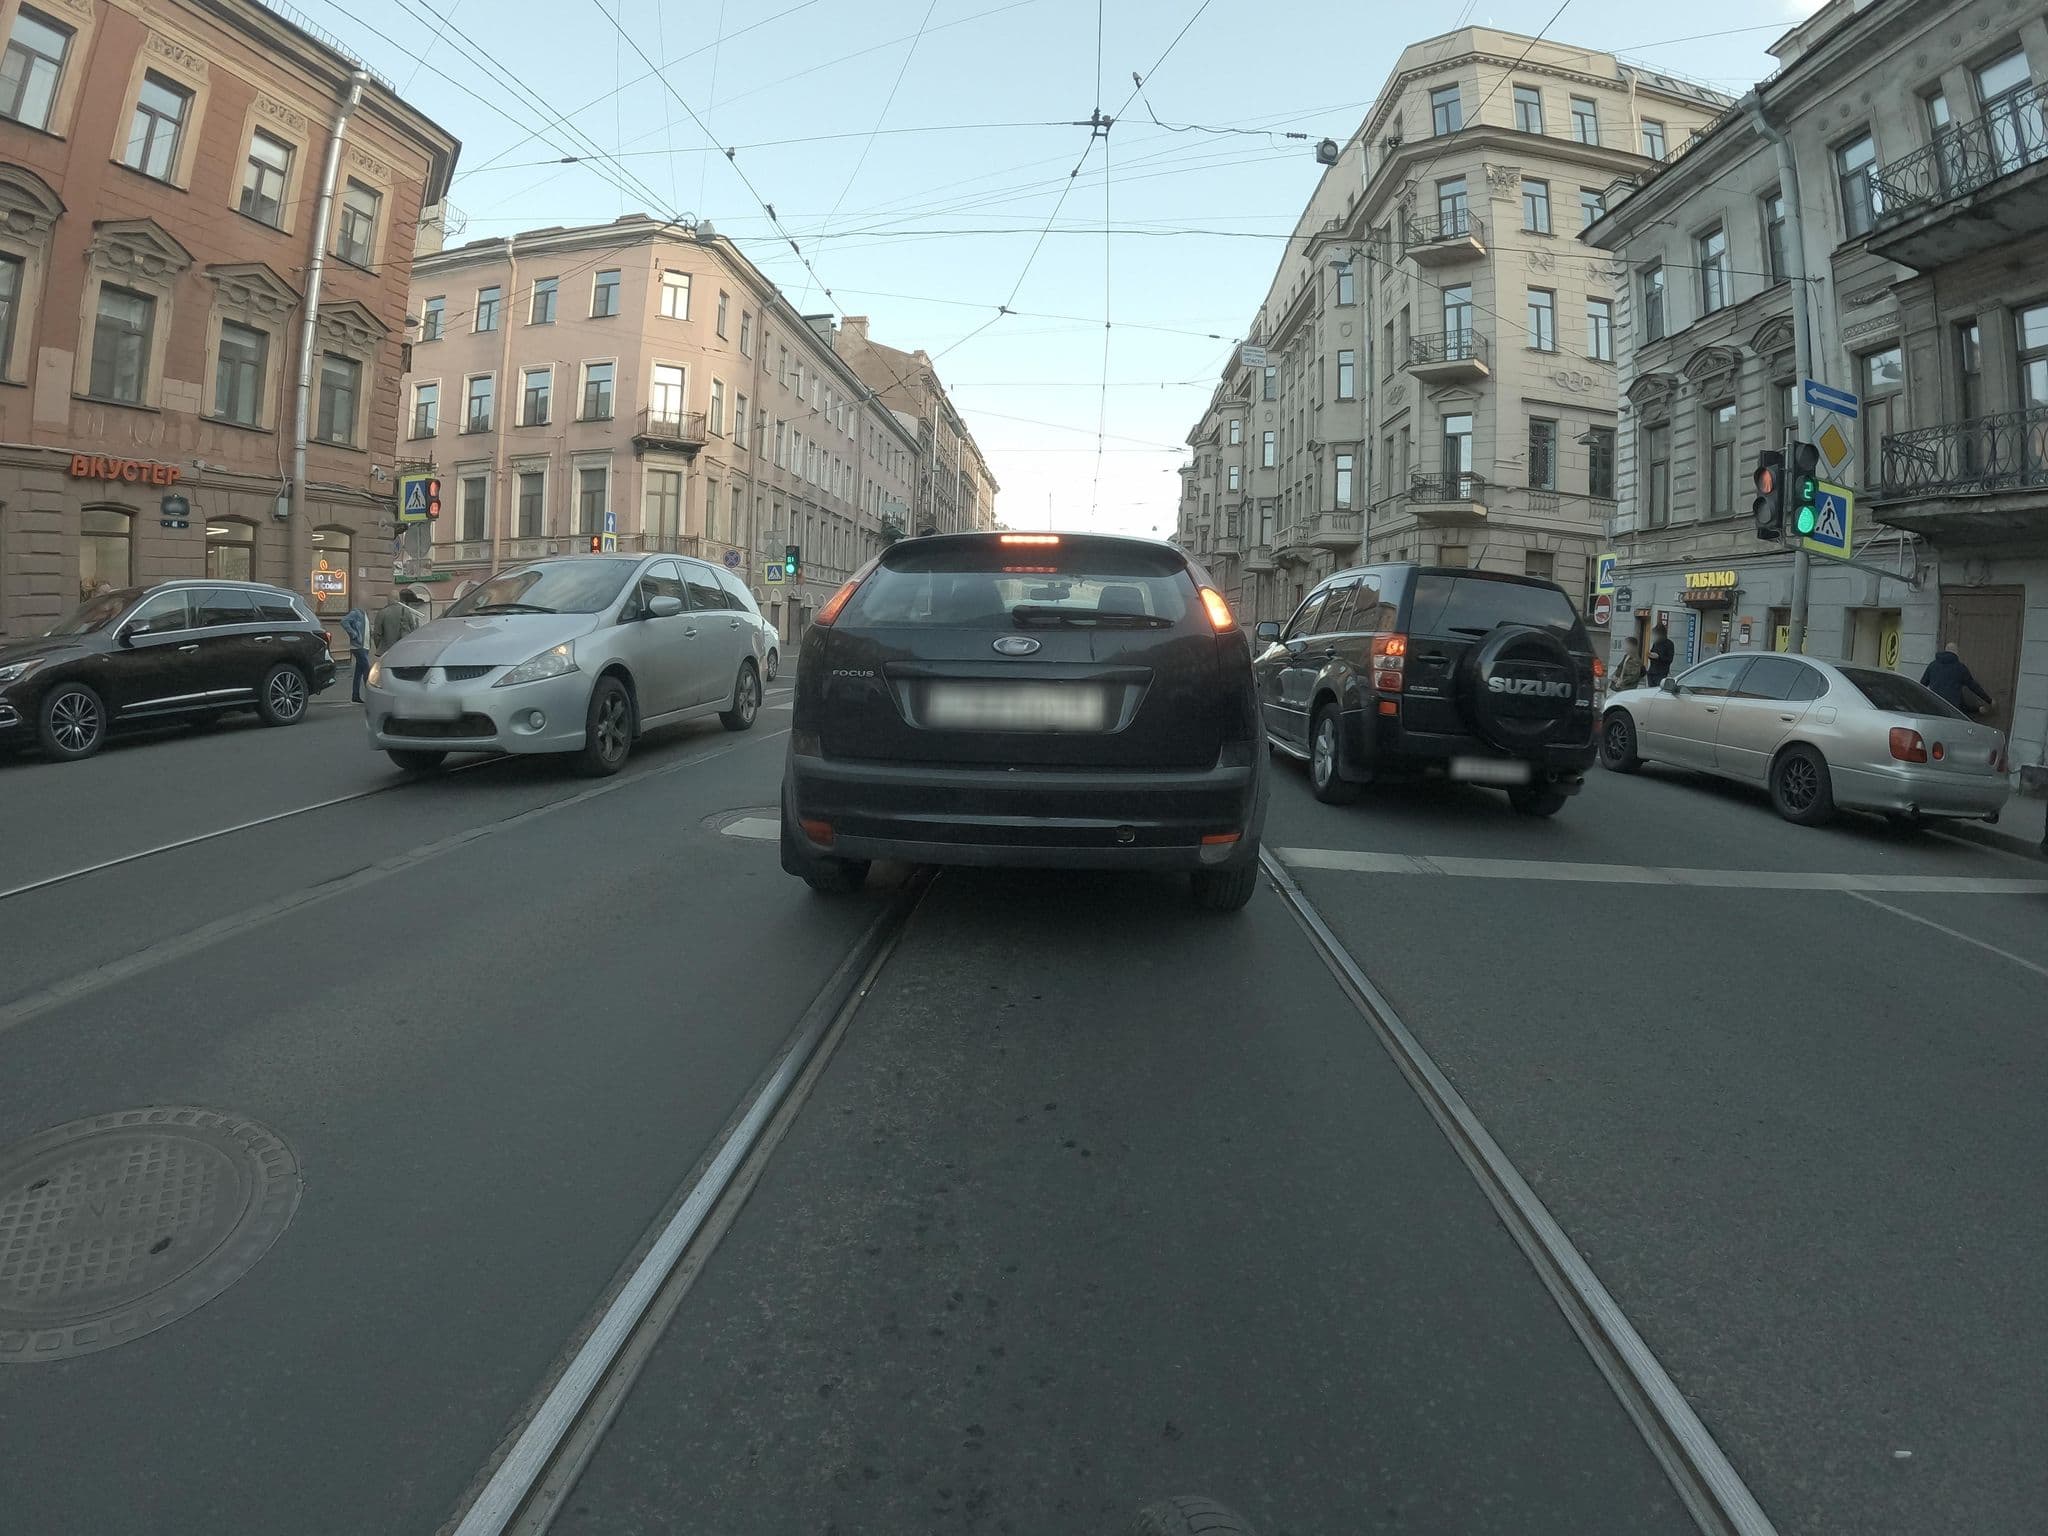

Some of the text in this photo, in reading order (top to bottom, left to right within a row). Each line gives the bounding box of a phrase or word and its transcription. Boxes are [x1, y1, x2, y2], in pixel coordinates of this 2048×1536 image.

[71, 454, 181, 486] ВКУСТЕР
[1685, 570, 1736, 589] ТАБАКО
[832, 669, 875, 678] FOCUS
[1488, 676, 1572, 699] SUZUKI
